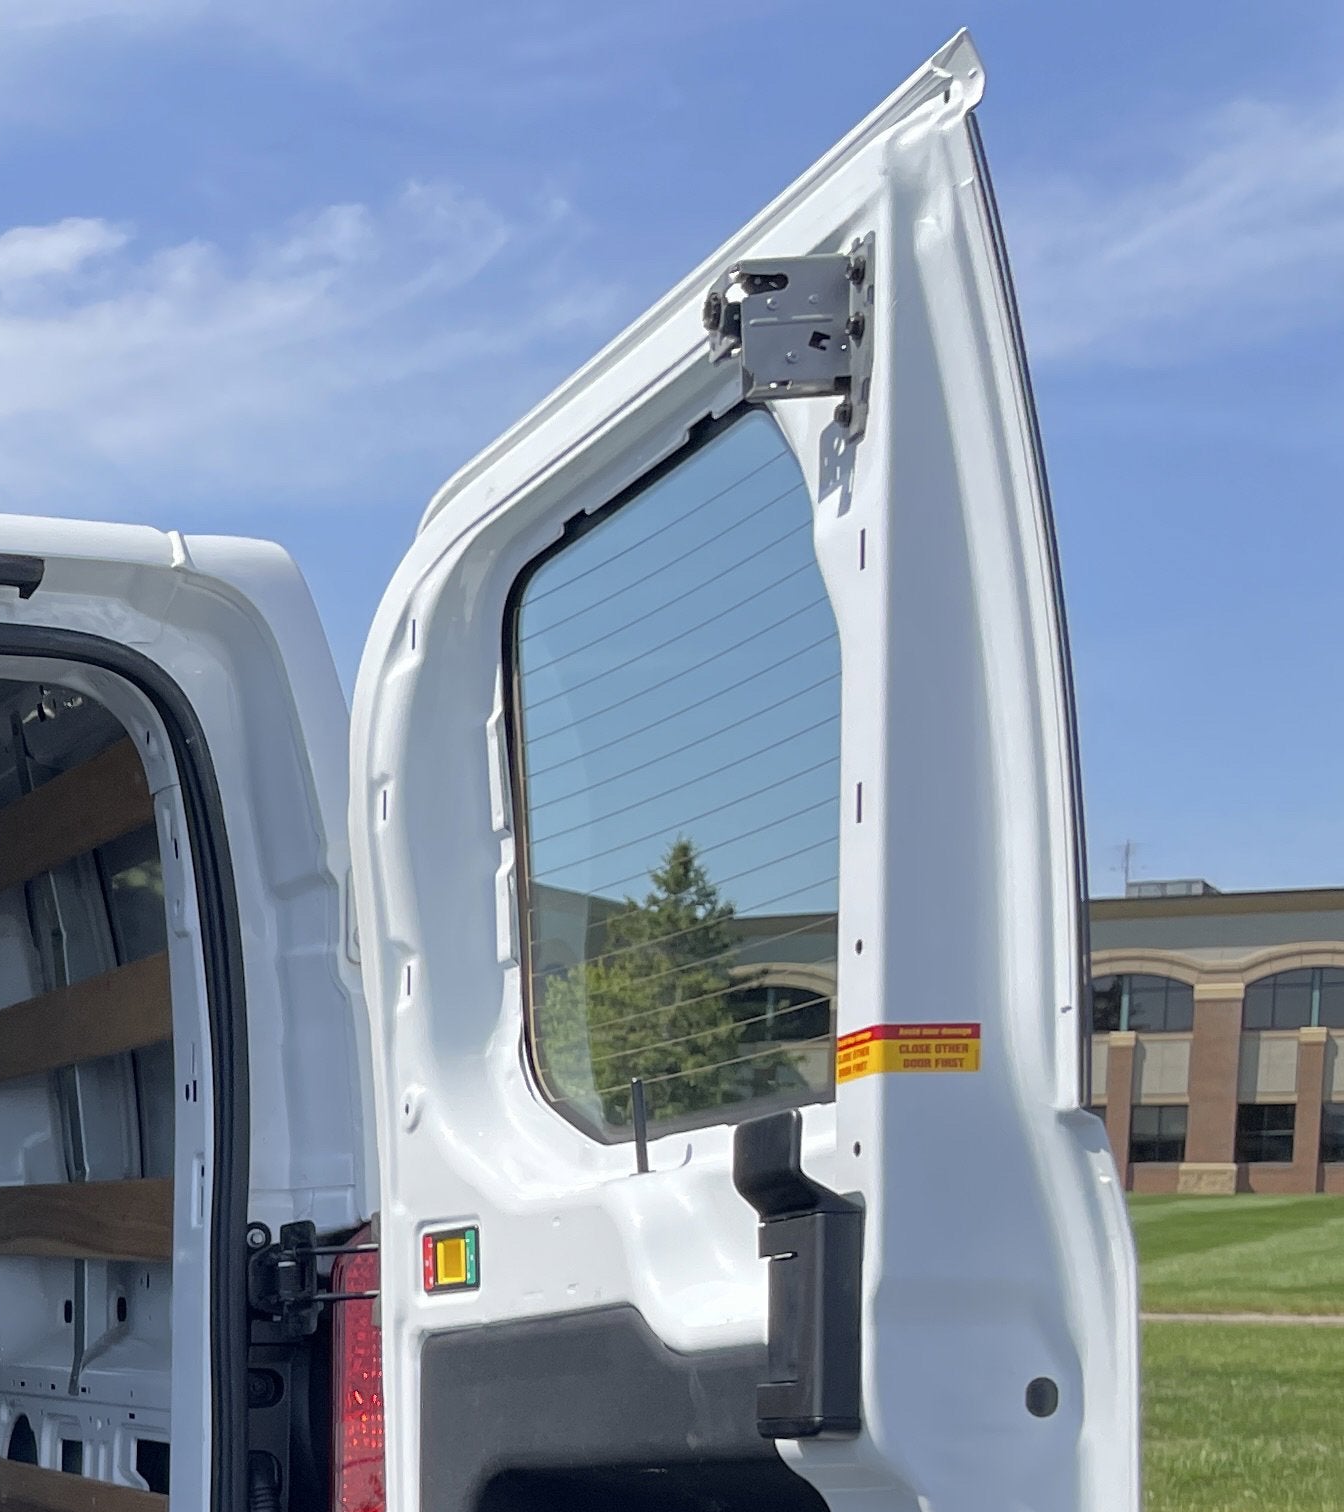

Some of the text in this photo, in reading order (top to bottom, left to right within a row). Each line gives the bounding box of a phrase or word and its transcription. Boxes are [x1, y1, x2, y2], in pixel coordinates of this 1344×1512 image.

[899, 1043, 969, 1054] CLOSE OTHER
[903, 1058, 964, 1068] DOOR FIRST
